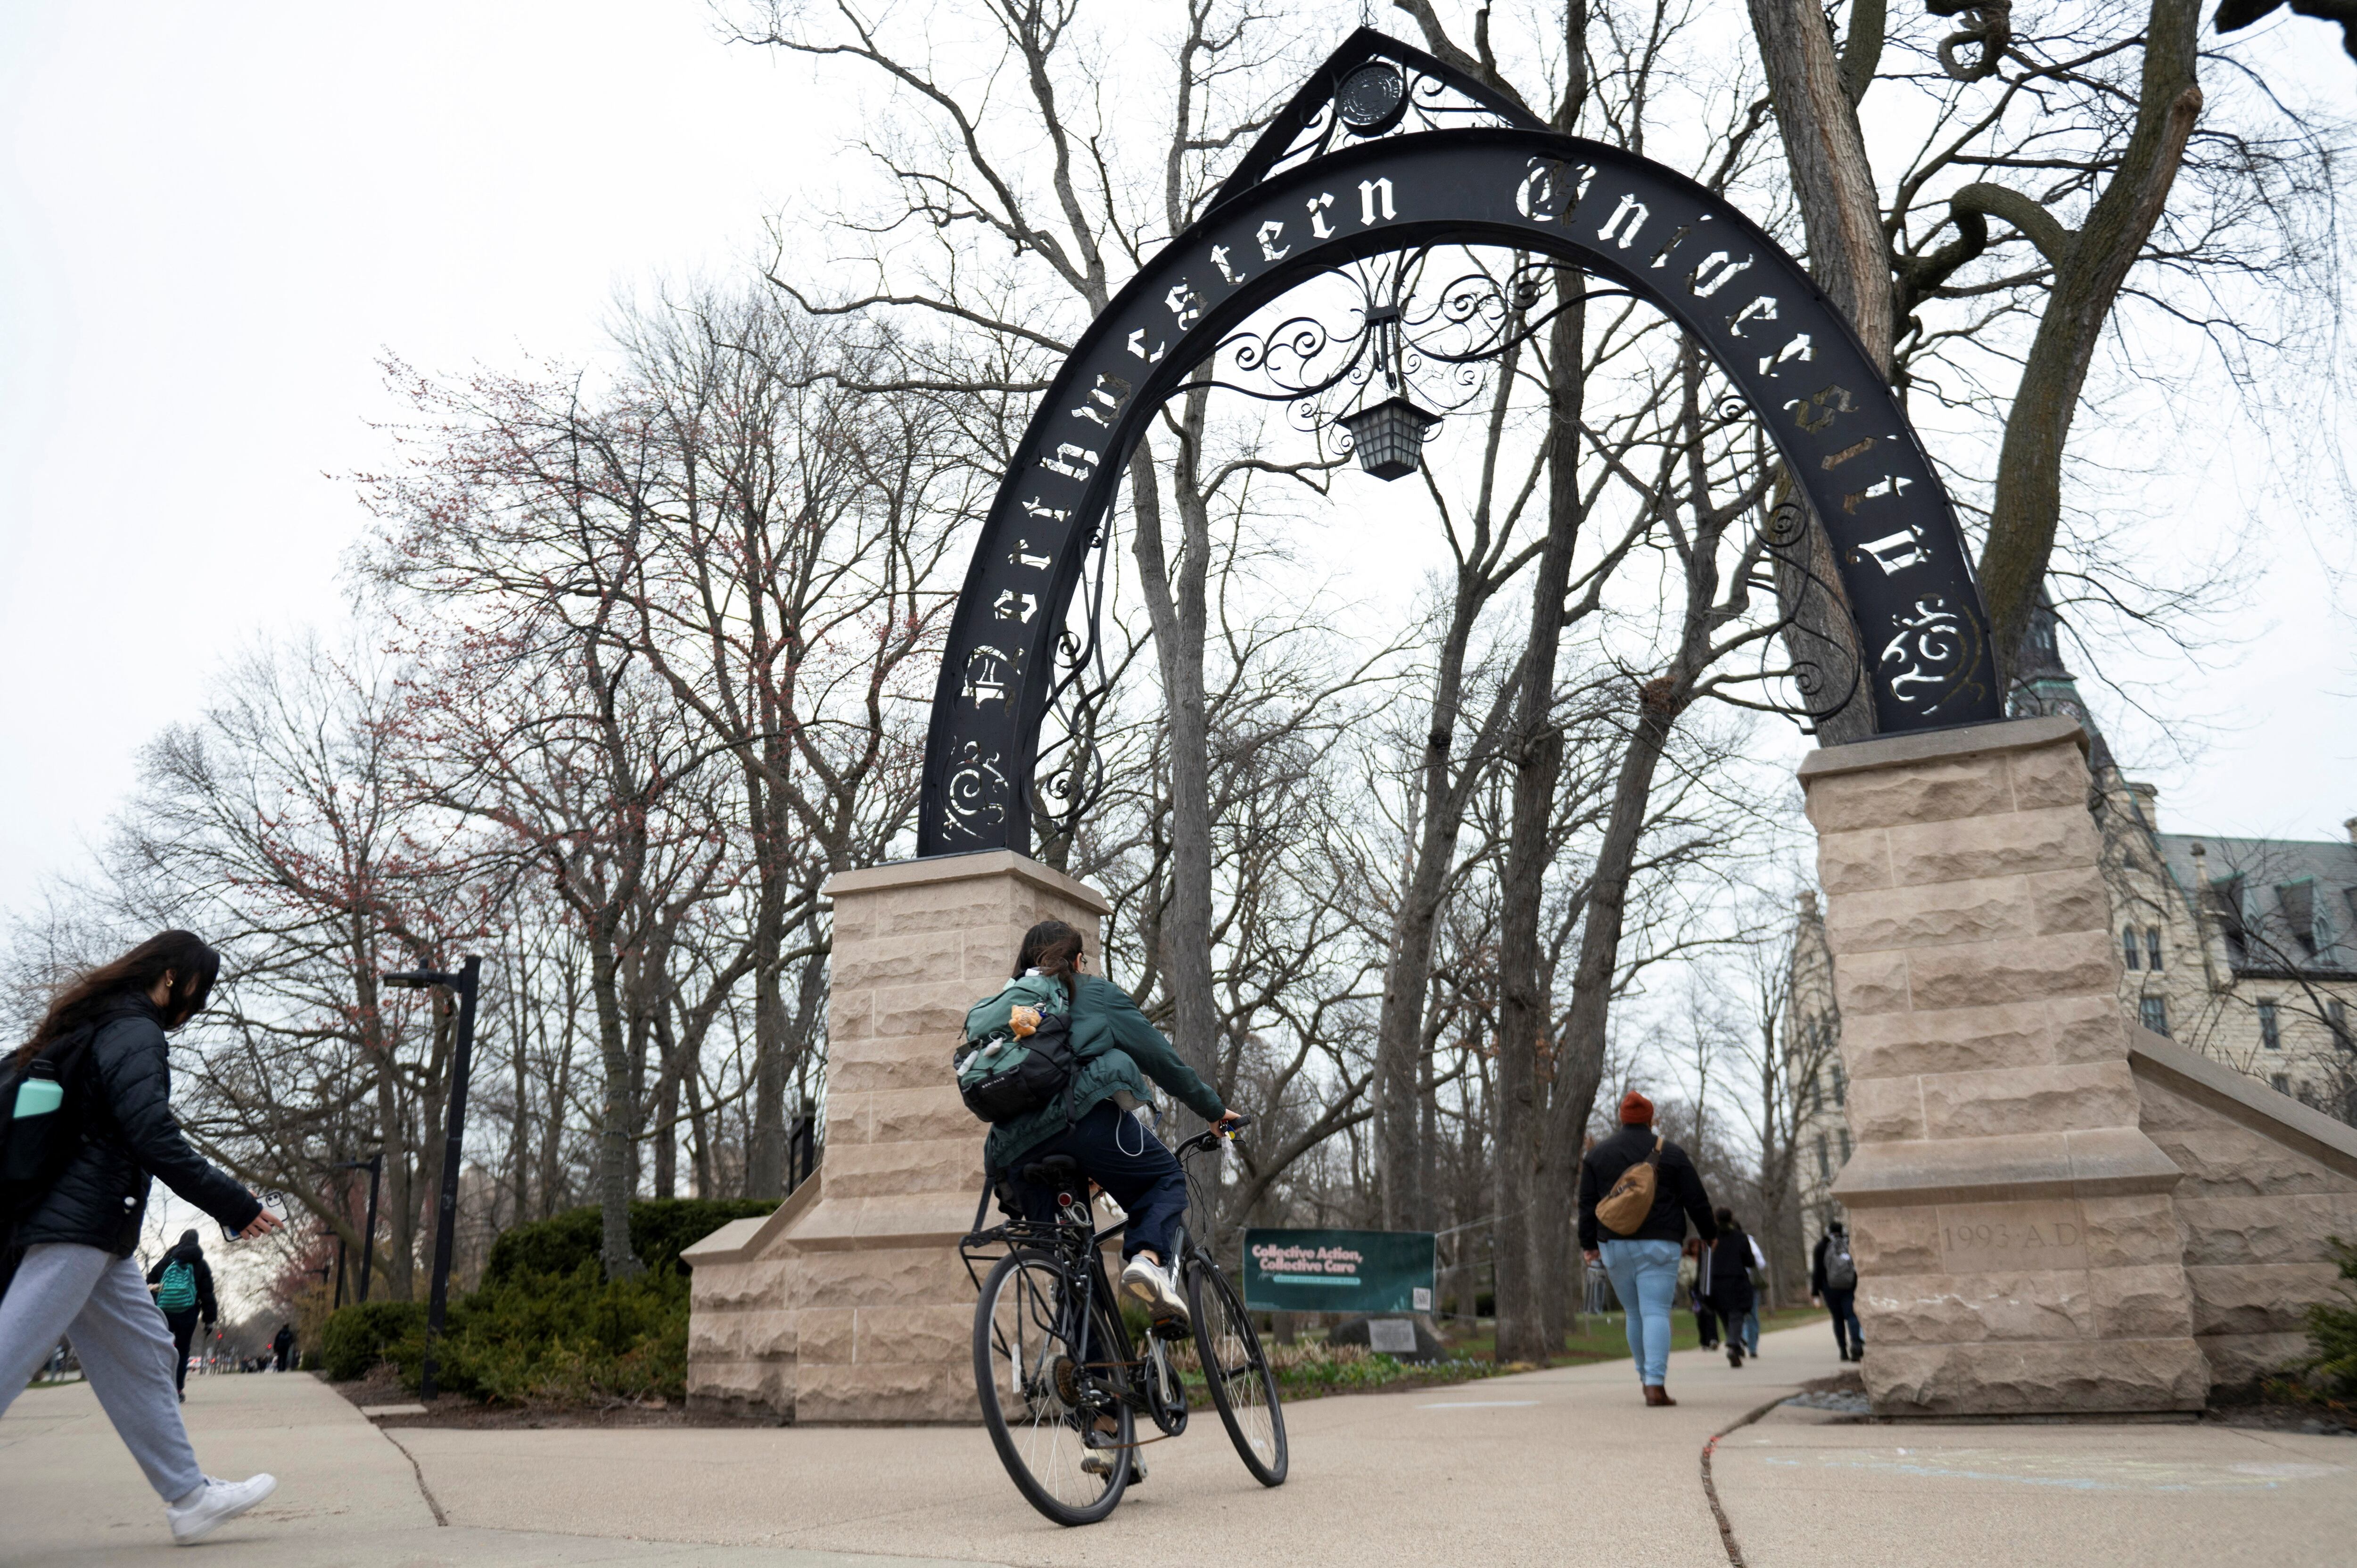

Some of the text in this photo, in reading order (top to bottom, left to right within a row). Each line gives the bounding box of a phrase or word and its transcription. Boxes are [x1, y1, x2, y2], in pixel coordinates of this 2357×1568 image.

[952, 152, 1931, 718] Northwestern University
[1252, 1244, 1363, 1263] Collective Action,
[1260, 1257, 1356, 1273] Collective Care
